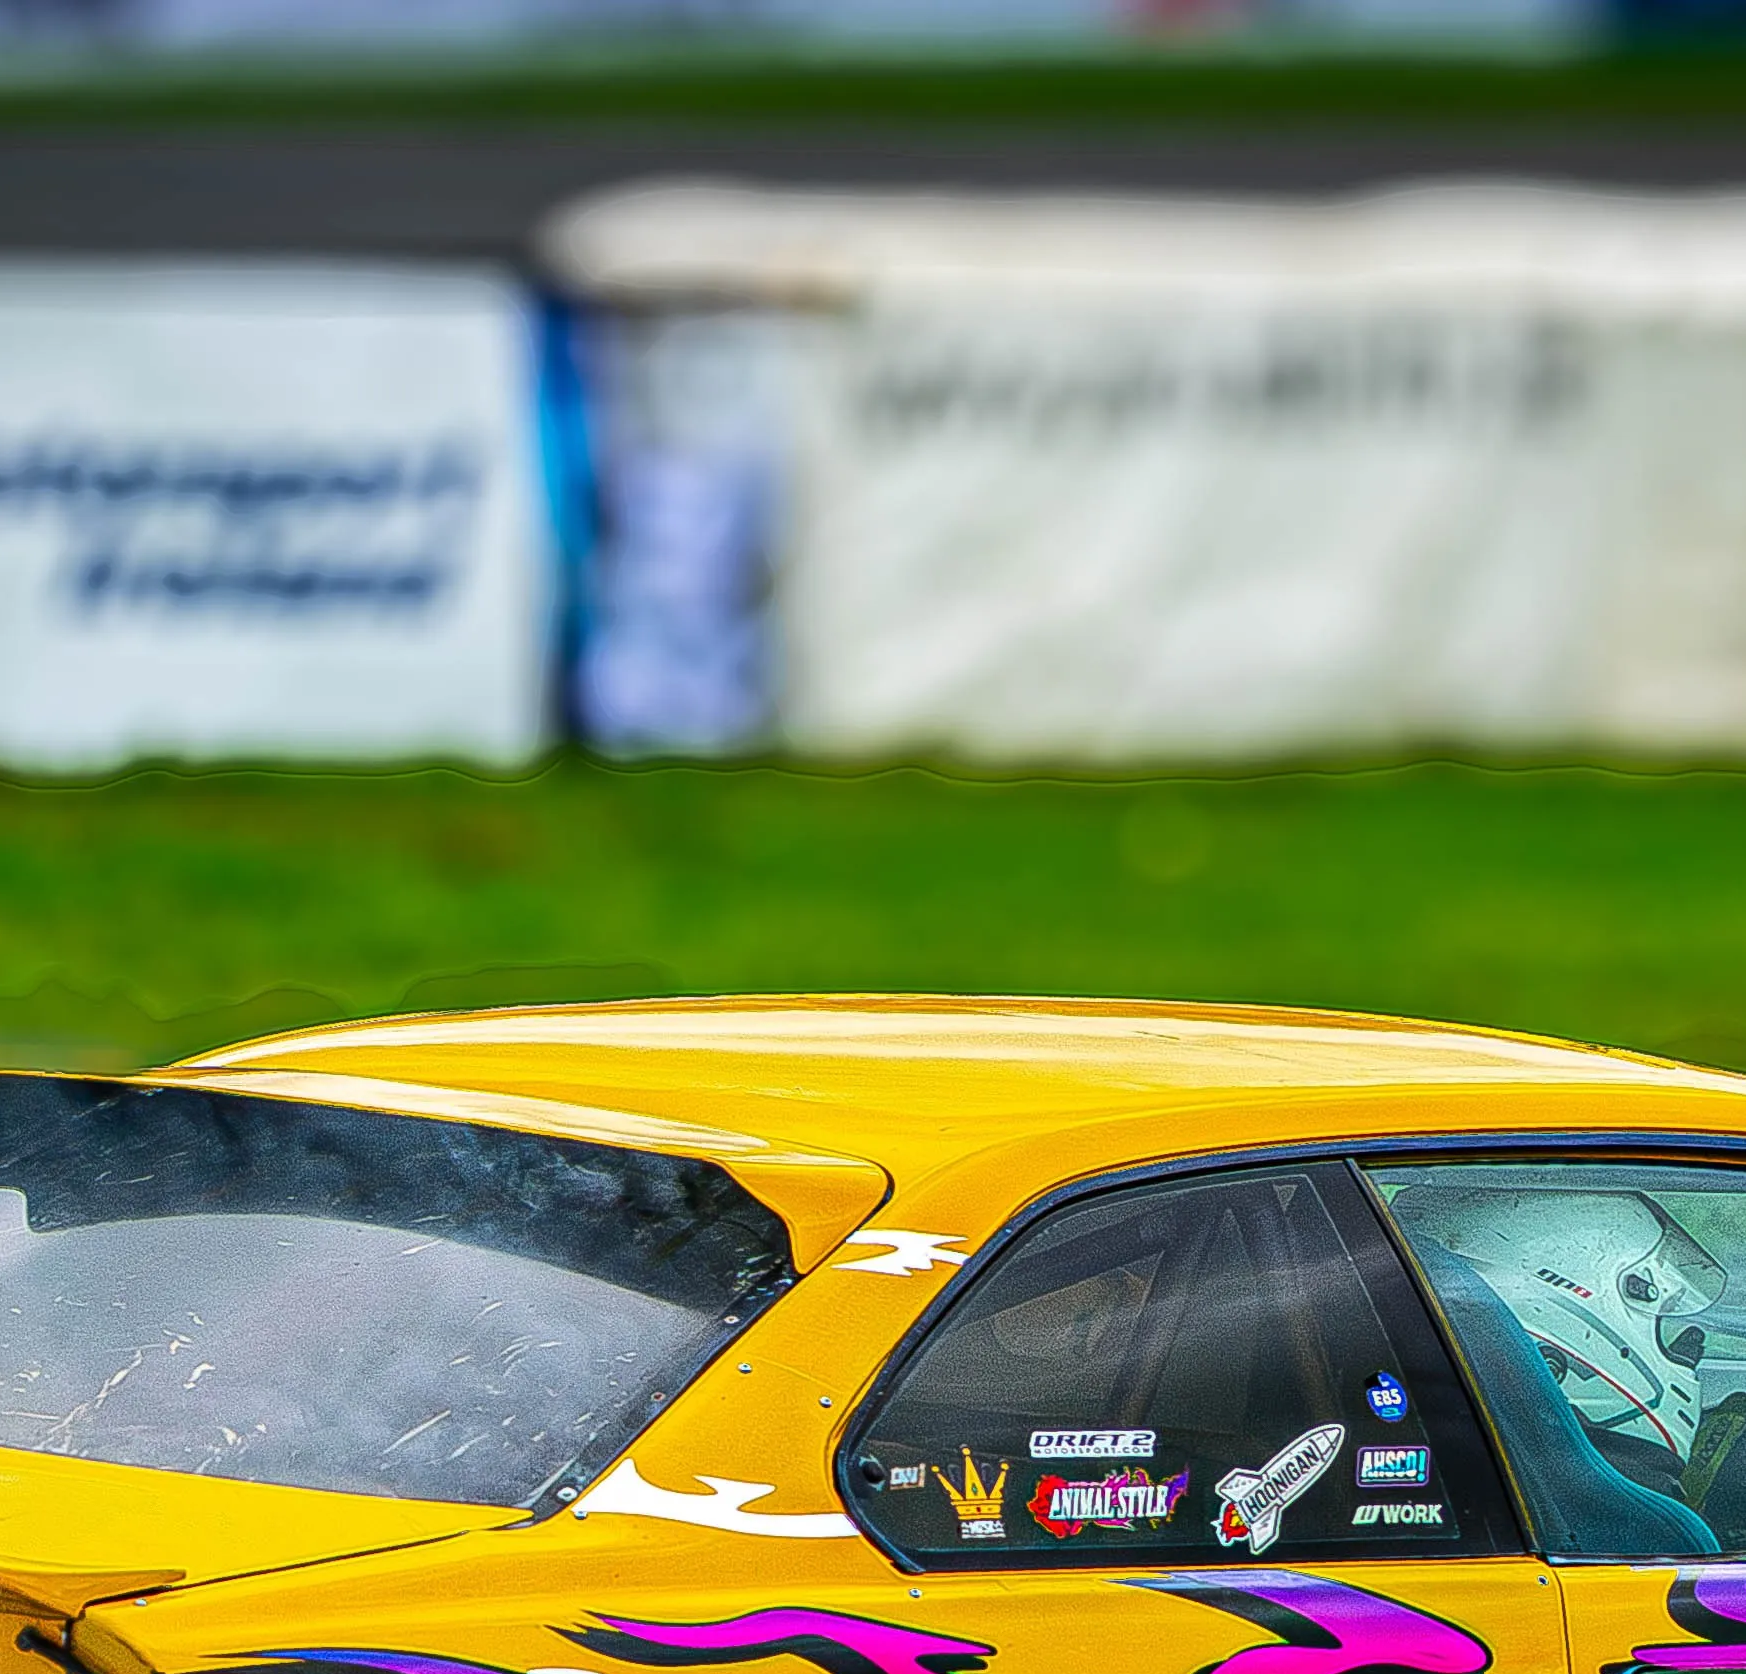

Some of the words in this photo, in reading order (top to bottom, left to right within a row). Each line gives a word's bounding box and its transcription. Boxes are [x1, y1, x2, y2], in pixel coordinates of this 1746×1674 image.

[1372, 1388, 1402, 1407] E85
[1034, 1434, 1125, 1447] DRIFT
[1132, 1433, 1152, 1446] 2
[1244, 1444, 1320, 1517] HOONIGAN
[1048, 1487, 1115, 1520] ANIMAL
[1116, 1485, 1169, 1518] STYLE
[1382, 1504, 1442, 1524] WORK
